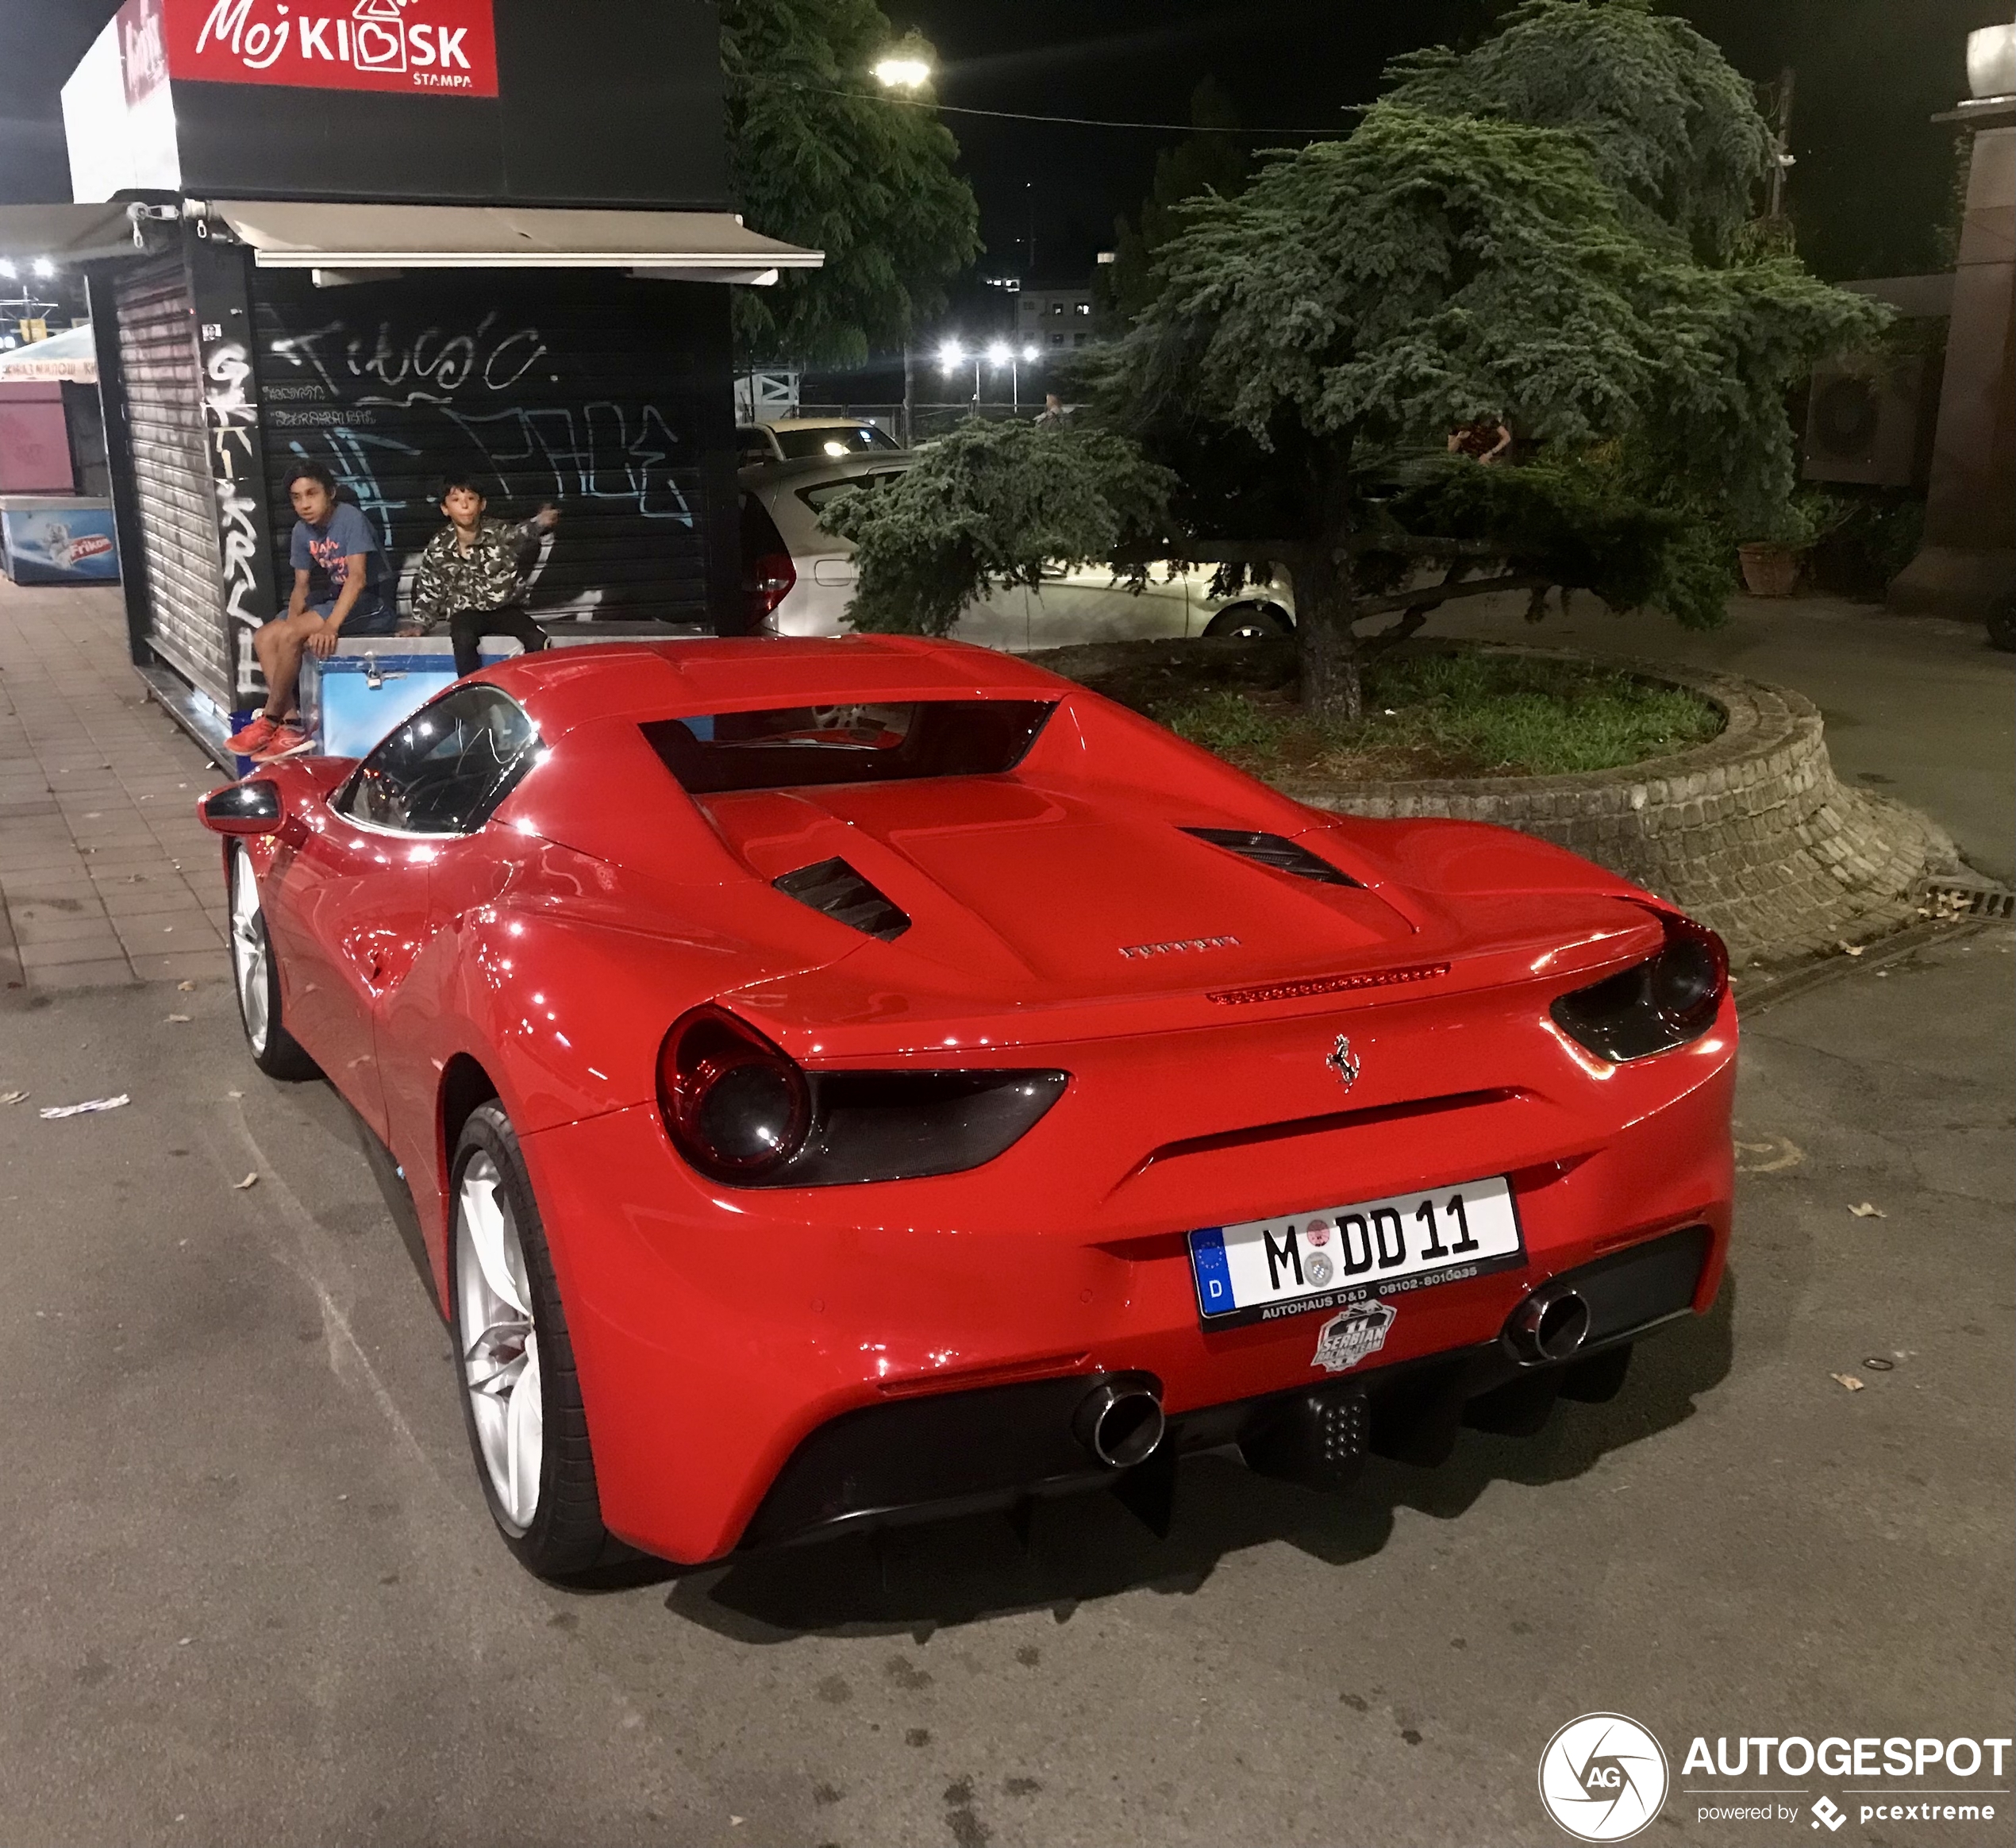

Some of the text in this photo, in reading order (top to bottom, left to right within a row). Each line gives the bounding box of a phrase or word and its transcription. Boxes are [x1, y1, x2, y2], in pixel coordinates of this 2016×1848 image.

[195, 0, 290, 69] Moj
[298, 16, 471, 71] KIOSK
[1263, 1225, 1304, 1290] M
[1335, 1207, 1407, 1276] DD
[1416, 1194, 1479, 1261] 11
[1209, 1279, 1223, 1298] D
[1262, 1296, 1333, 1320] AUTOHAUS
[1337, 1289, 1368, 1305] D&D
[1322, 1326, 1385, 1353] SERBIAN
